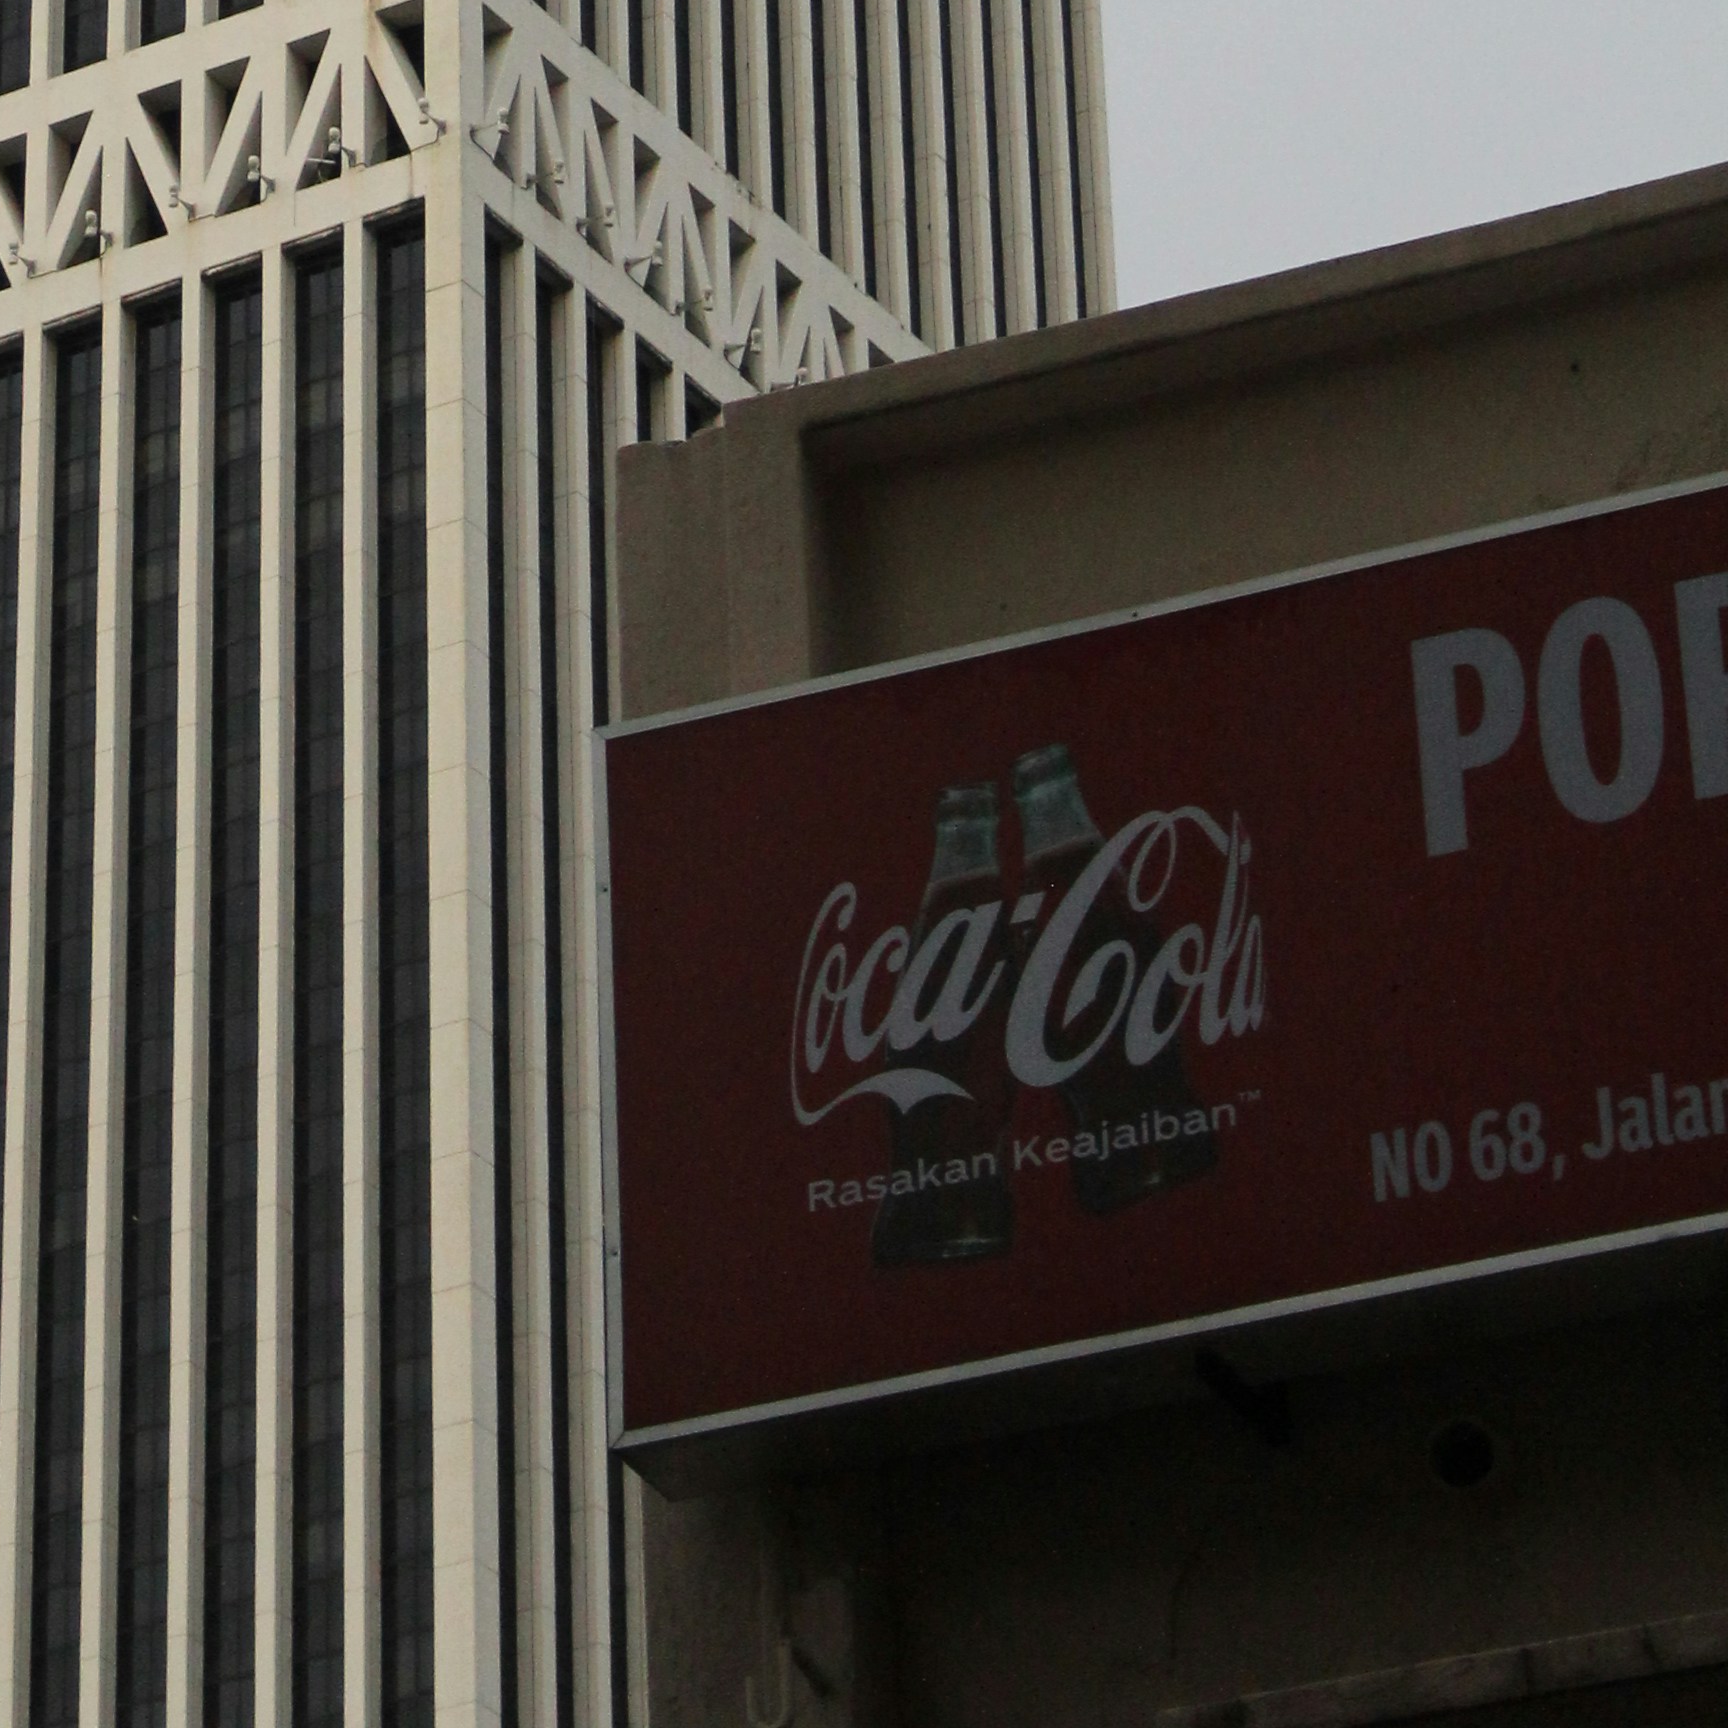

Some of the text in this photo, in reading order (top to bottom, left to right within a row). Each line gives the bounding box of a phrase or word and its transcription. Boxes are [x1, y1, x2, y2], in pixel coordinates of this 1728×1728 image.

[791, 806, 1264, 1126] Coca-Cola
[808, 1152, 996, 1212] Rasakan
[1370, 1120, 1452, 1203] NO
[1469, 1101, 1565, 1182] 68,
